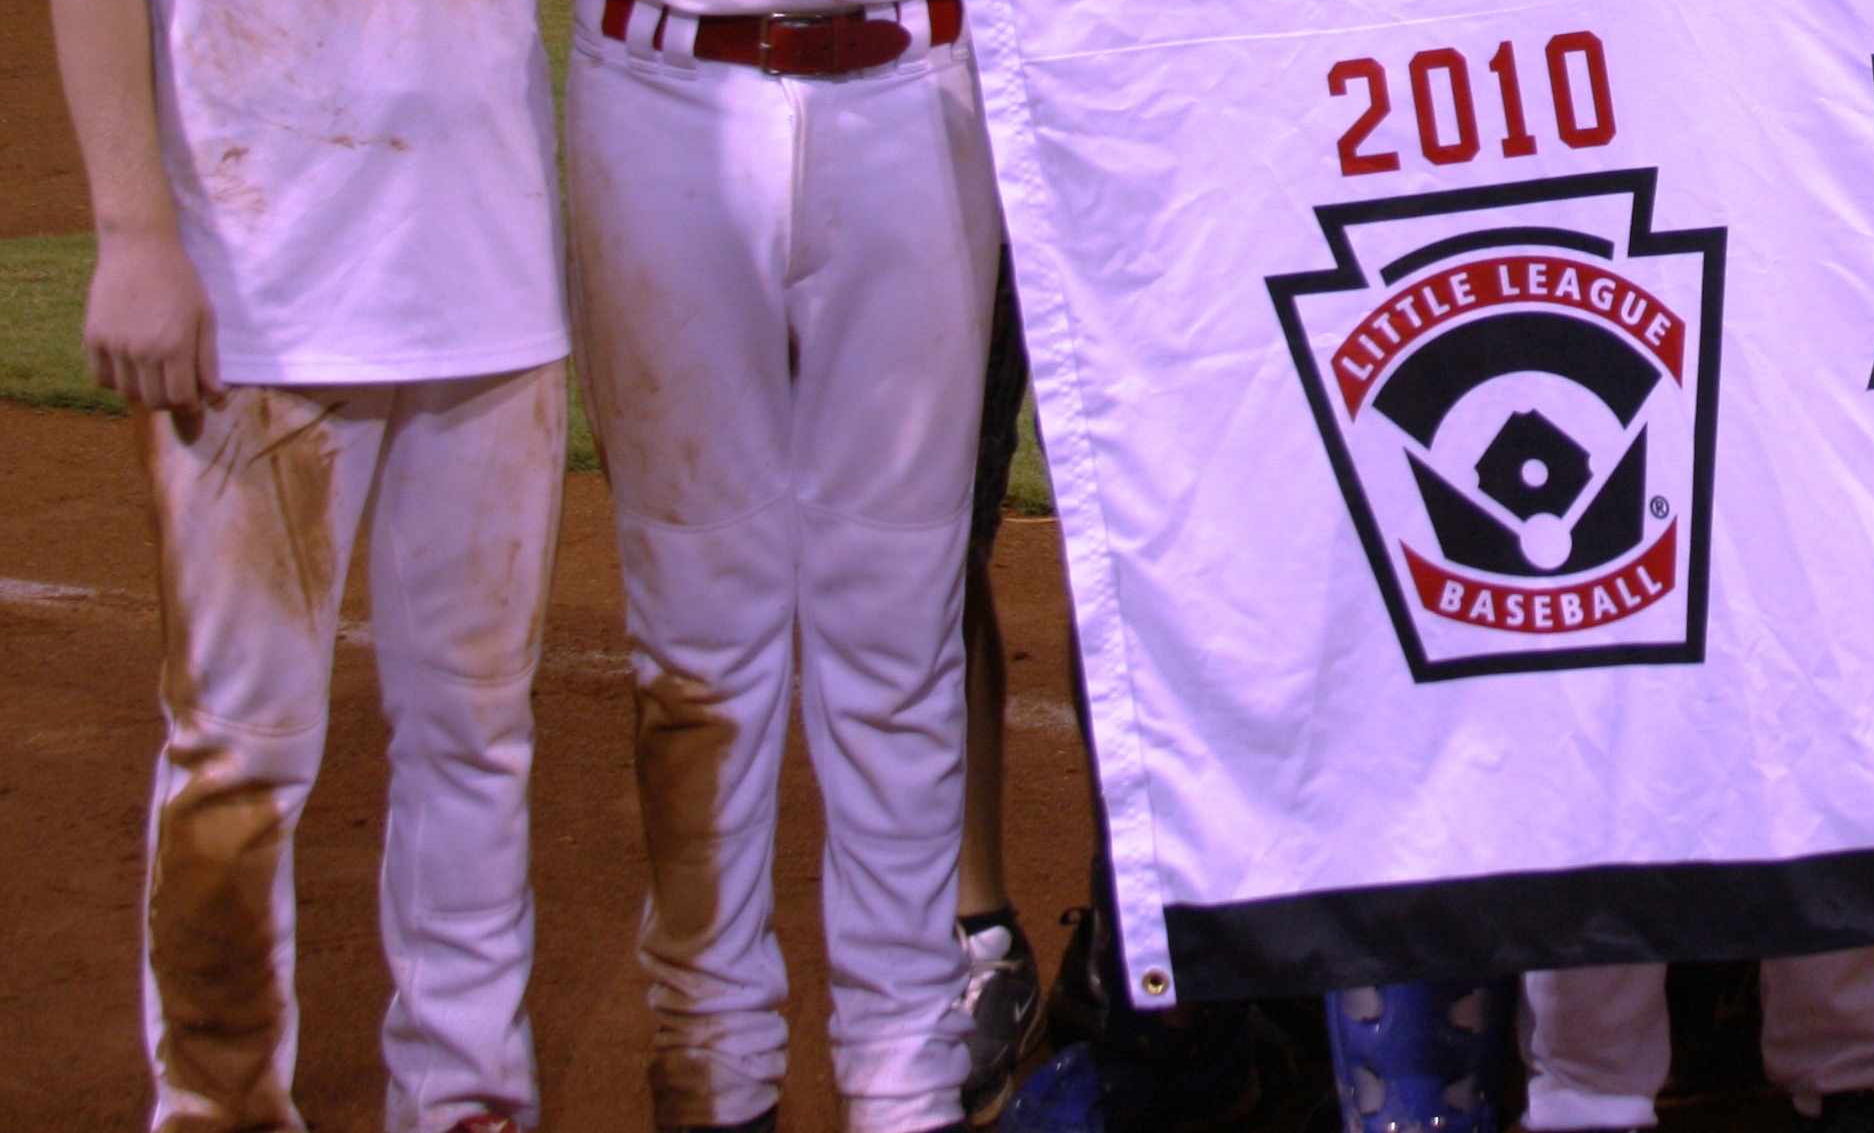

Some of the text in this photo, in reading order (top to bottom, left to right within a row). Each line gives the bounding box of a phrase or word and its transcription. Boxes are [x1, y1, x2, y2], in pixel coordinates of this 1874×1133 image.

[1327, 30, 1617, 177] 2010
[1341, 263, 1673, 382] LITTLE LEAGUE
[1438, 565, 1663, 629] BASEBALL
